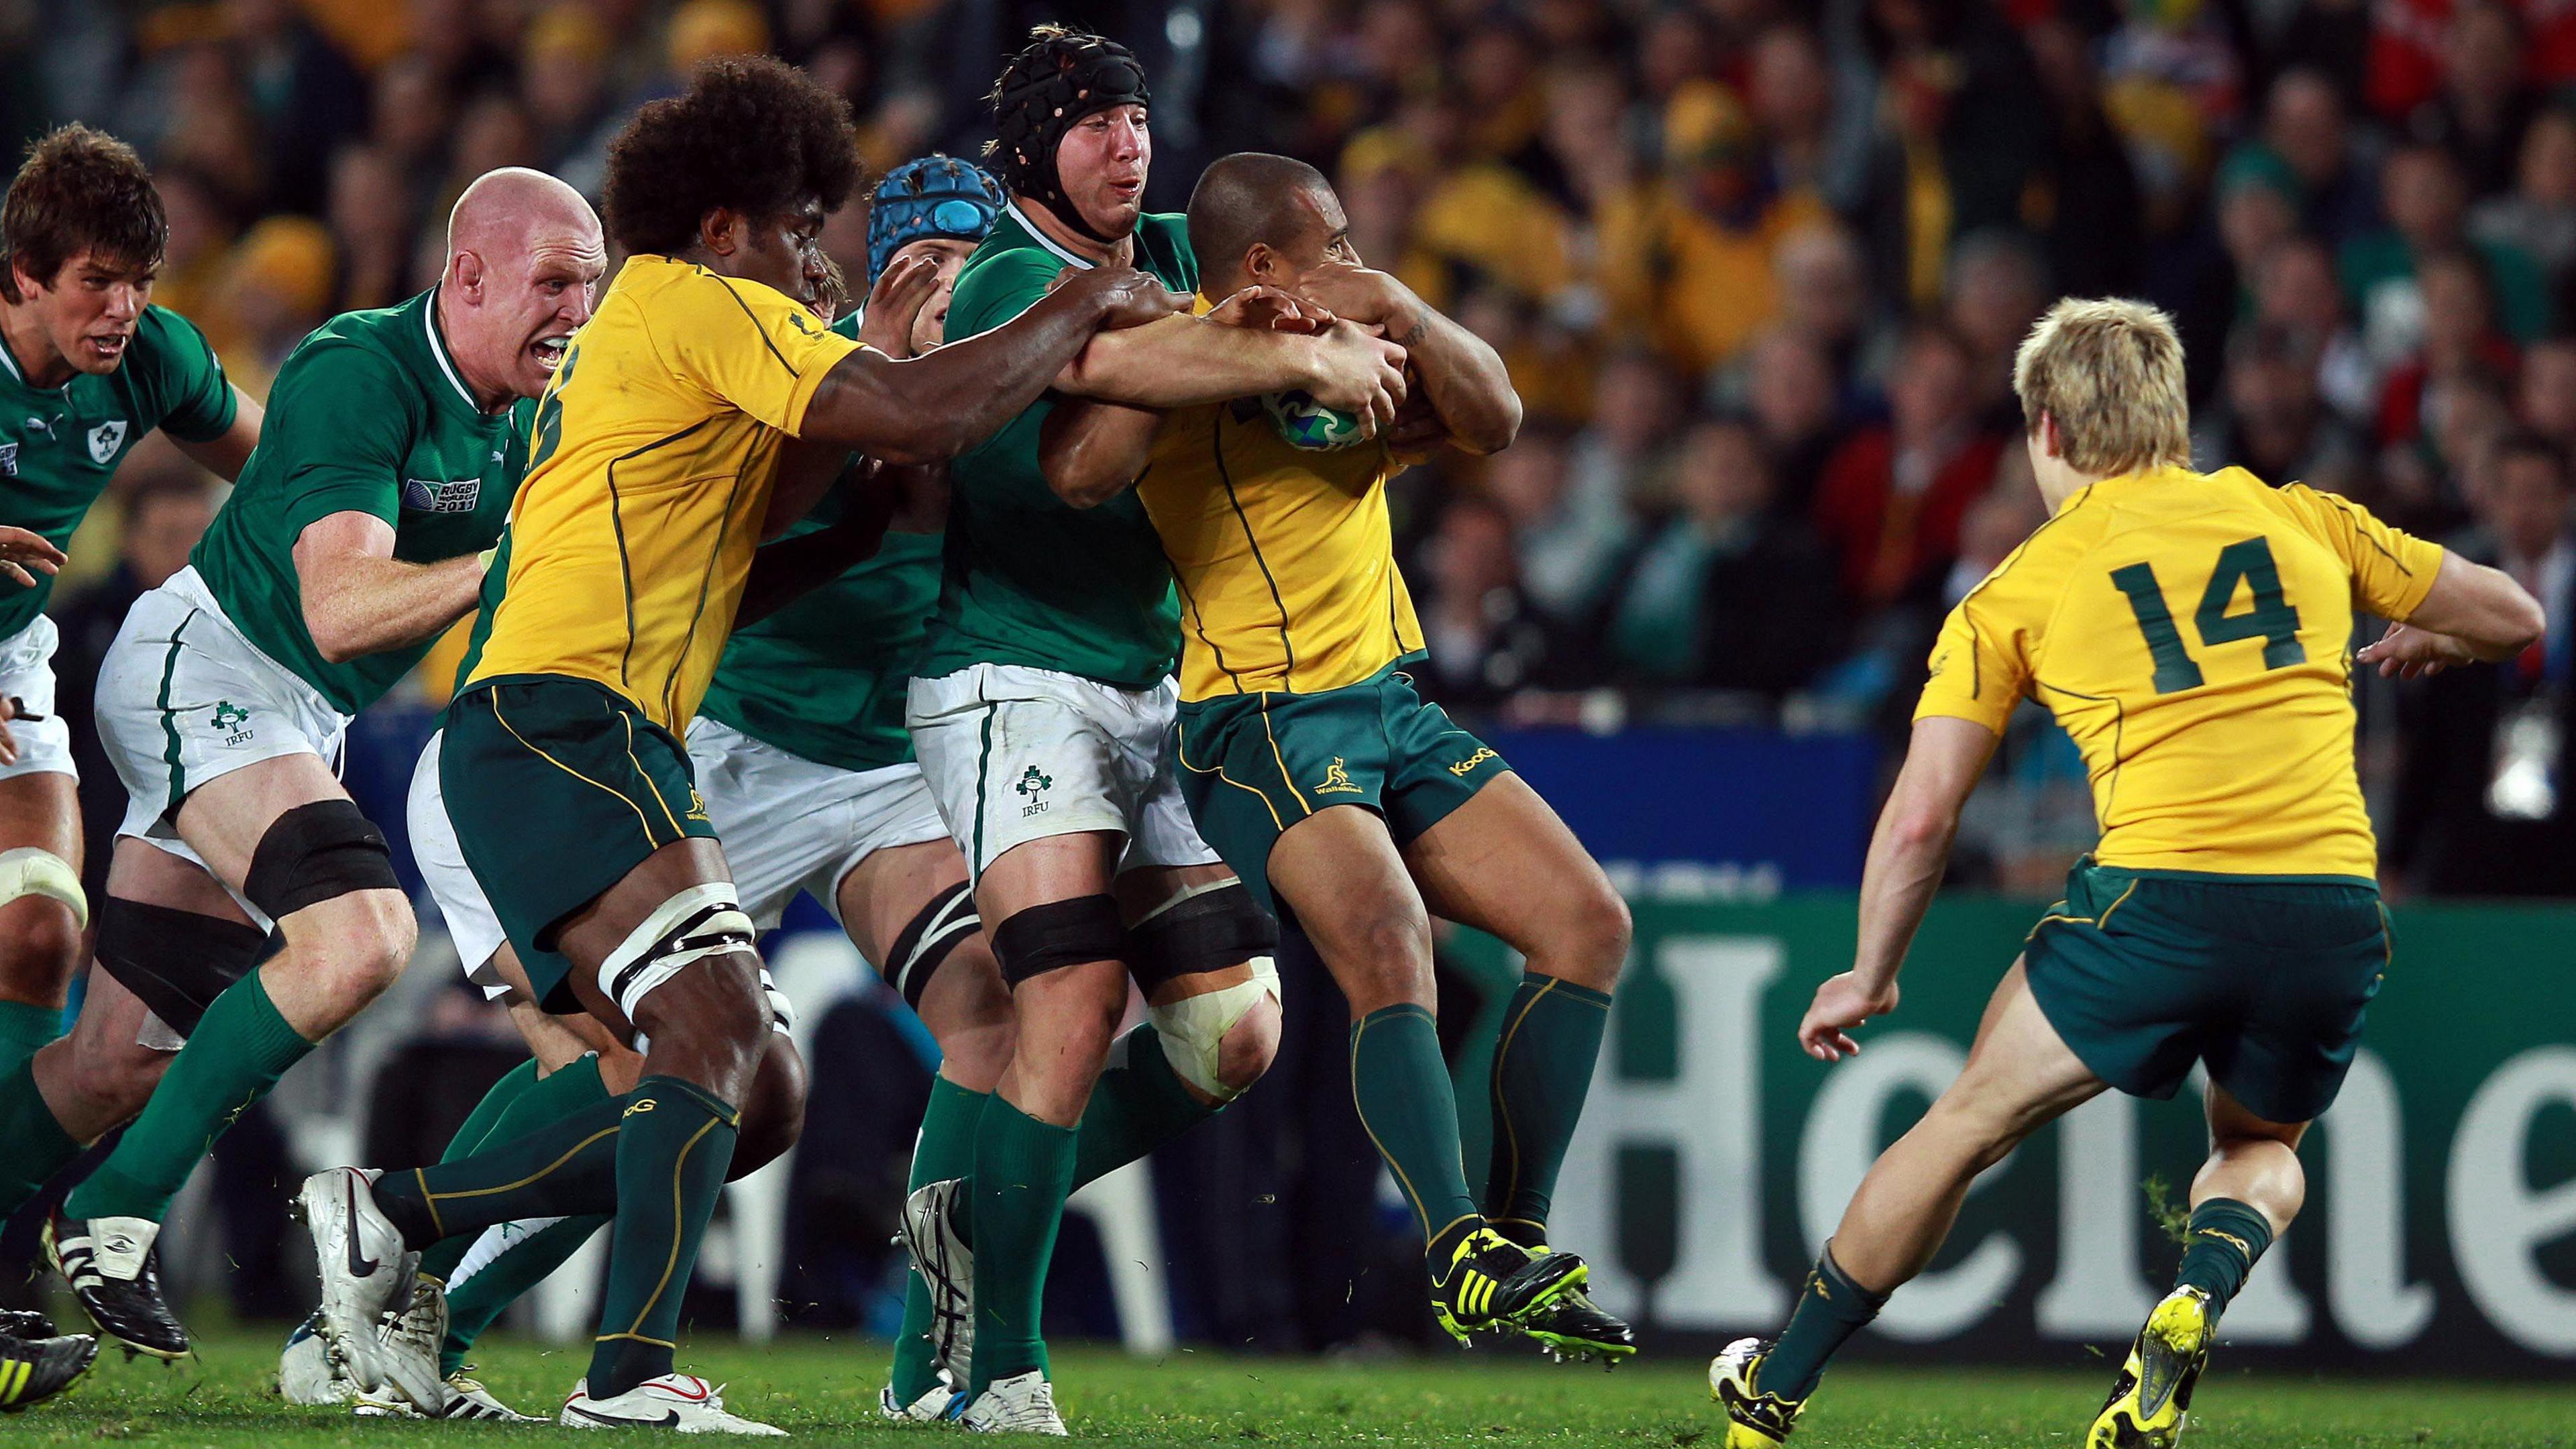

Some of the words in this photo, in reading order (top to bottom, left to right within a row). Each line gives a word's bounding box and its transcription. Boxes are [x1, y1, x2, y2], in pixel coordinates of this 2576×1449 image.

[441, 482, 478, 495] RUGBY
[435, 500, 474, 512] 2011
[2108, 535, 2306, 695] 14
[225, 729, 254, 746] IRFU
[1022, 801, 1049, 818] IRFU
